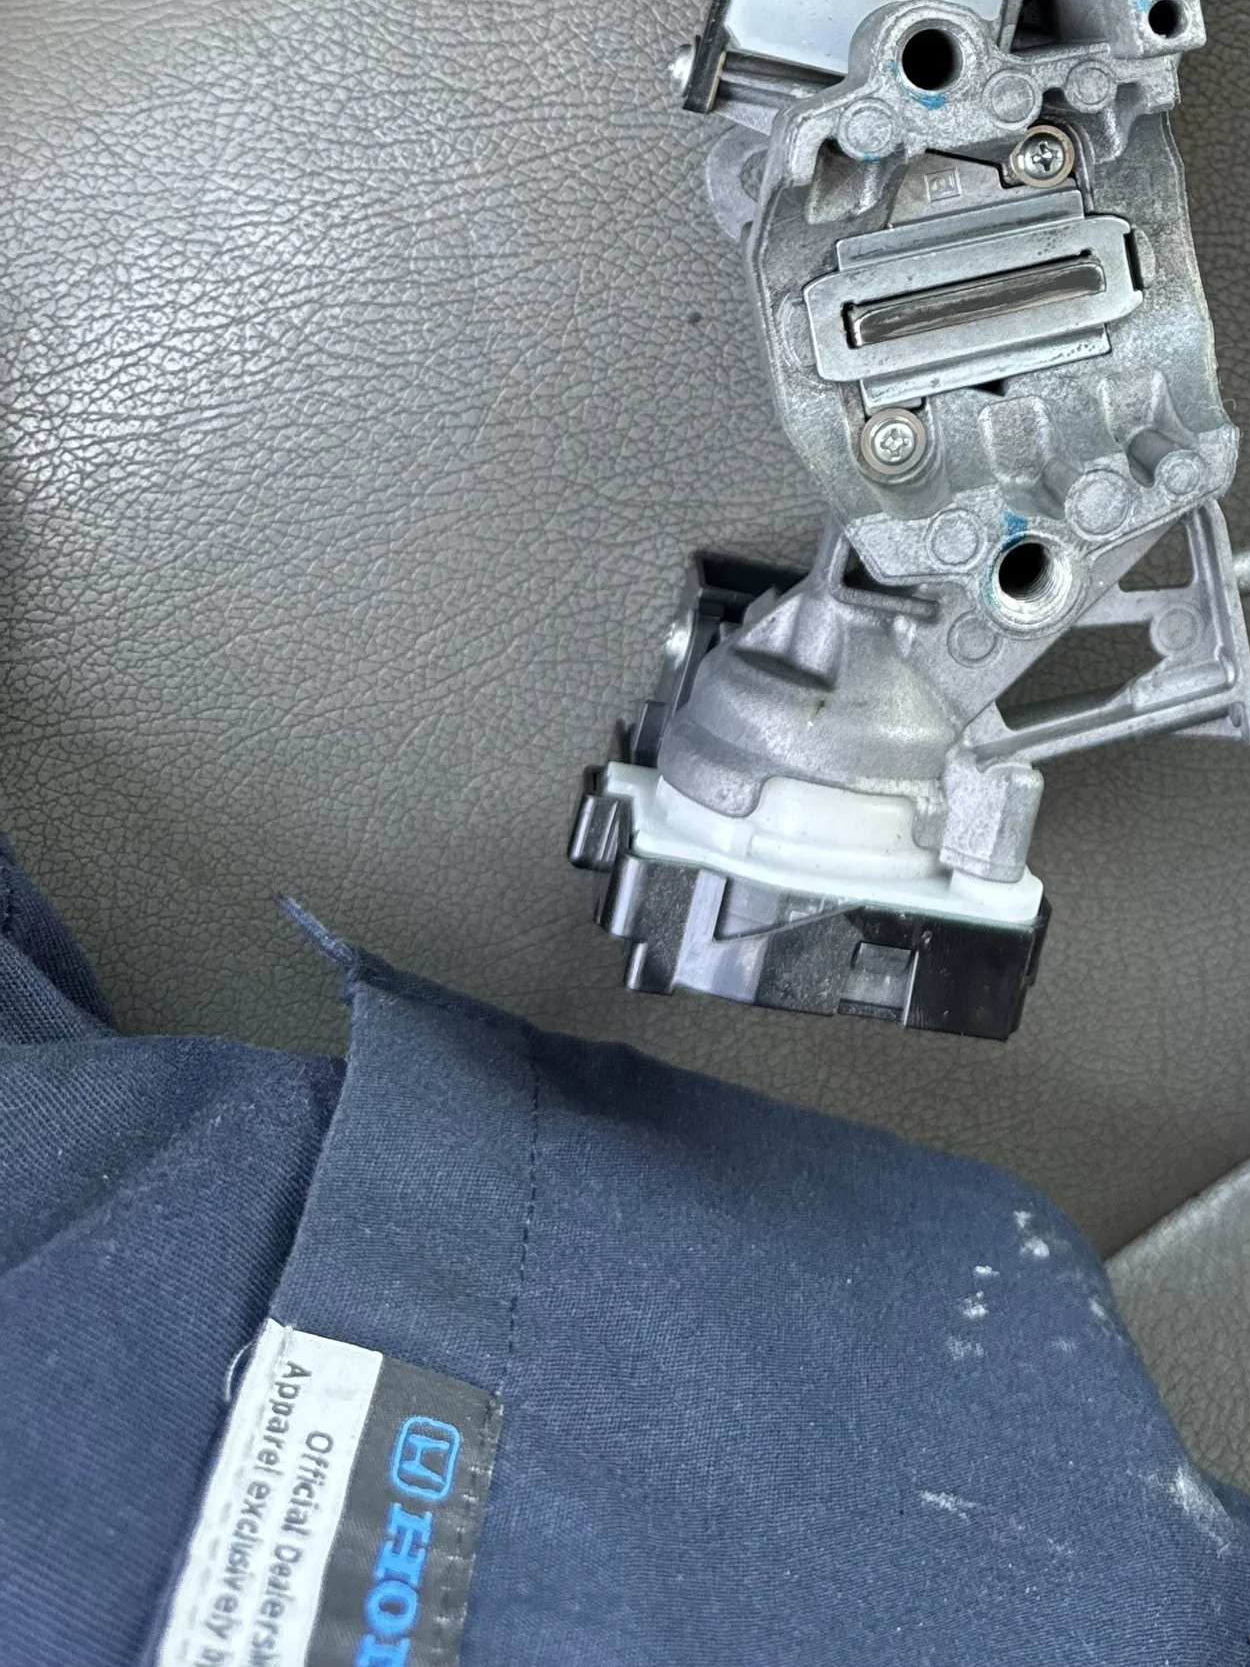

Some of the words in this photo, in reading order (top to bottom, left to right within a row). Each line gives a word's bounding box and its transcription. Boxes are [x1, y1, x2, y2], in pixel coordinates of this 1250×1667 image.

[255, 1360, 313, 1477] Apparel
[281, 1429, 335, 1537] Official
[204, 1481, 272, 1640] exclusively
